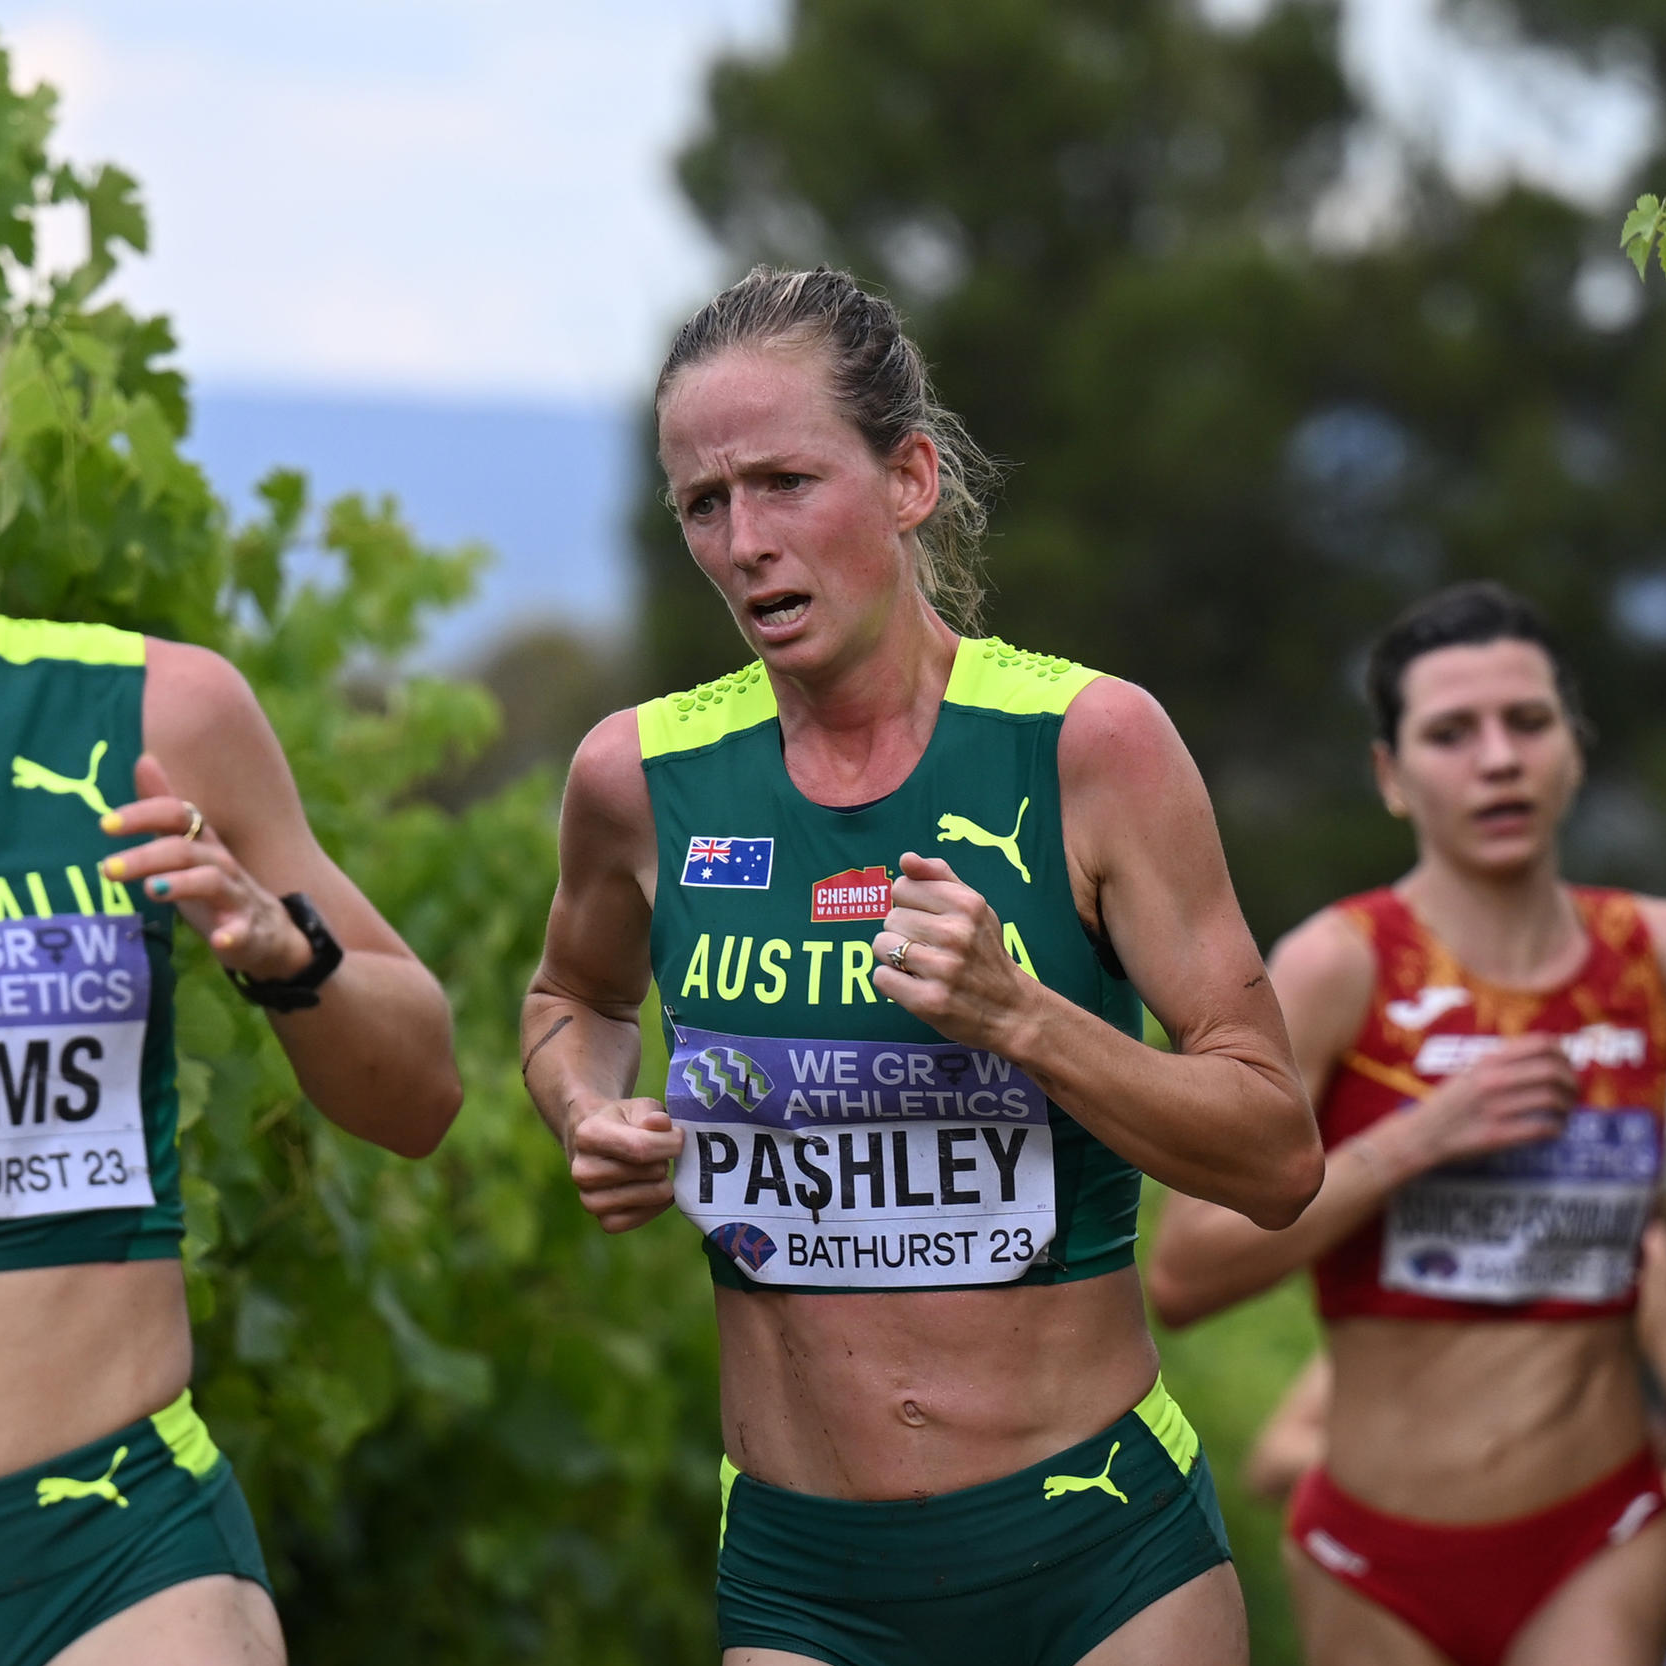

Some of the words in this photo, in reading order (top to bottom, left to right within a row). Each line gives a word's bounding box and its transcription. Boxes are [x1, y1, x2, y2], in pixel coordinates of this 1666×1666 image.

[817, 885, 888, 905] CHEMIST
[817, 904, 886, 915] WAREHOUSE
[680, 922, 1040, 1005] AUSTRA
[788, 1050, 858, 1084] WE
[783, 1088, 1030, 1120] ATHLETICS
[84, 1149, 128, 1186] 23
[696, 1128, 1028, 1209] PASHLEY
[788, 1231, 978, 1268] BATHURST
[989, 1228, 1034, 1263] 23
